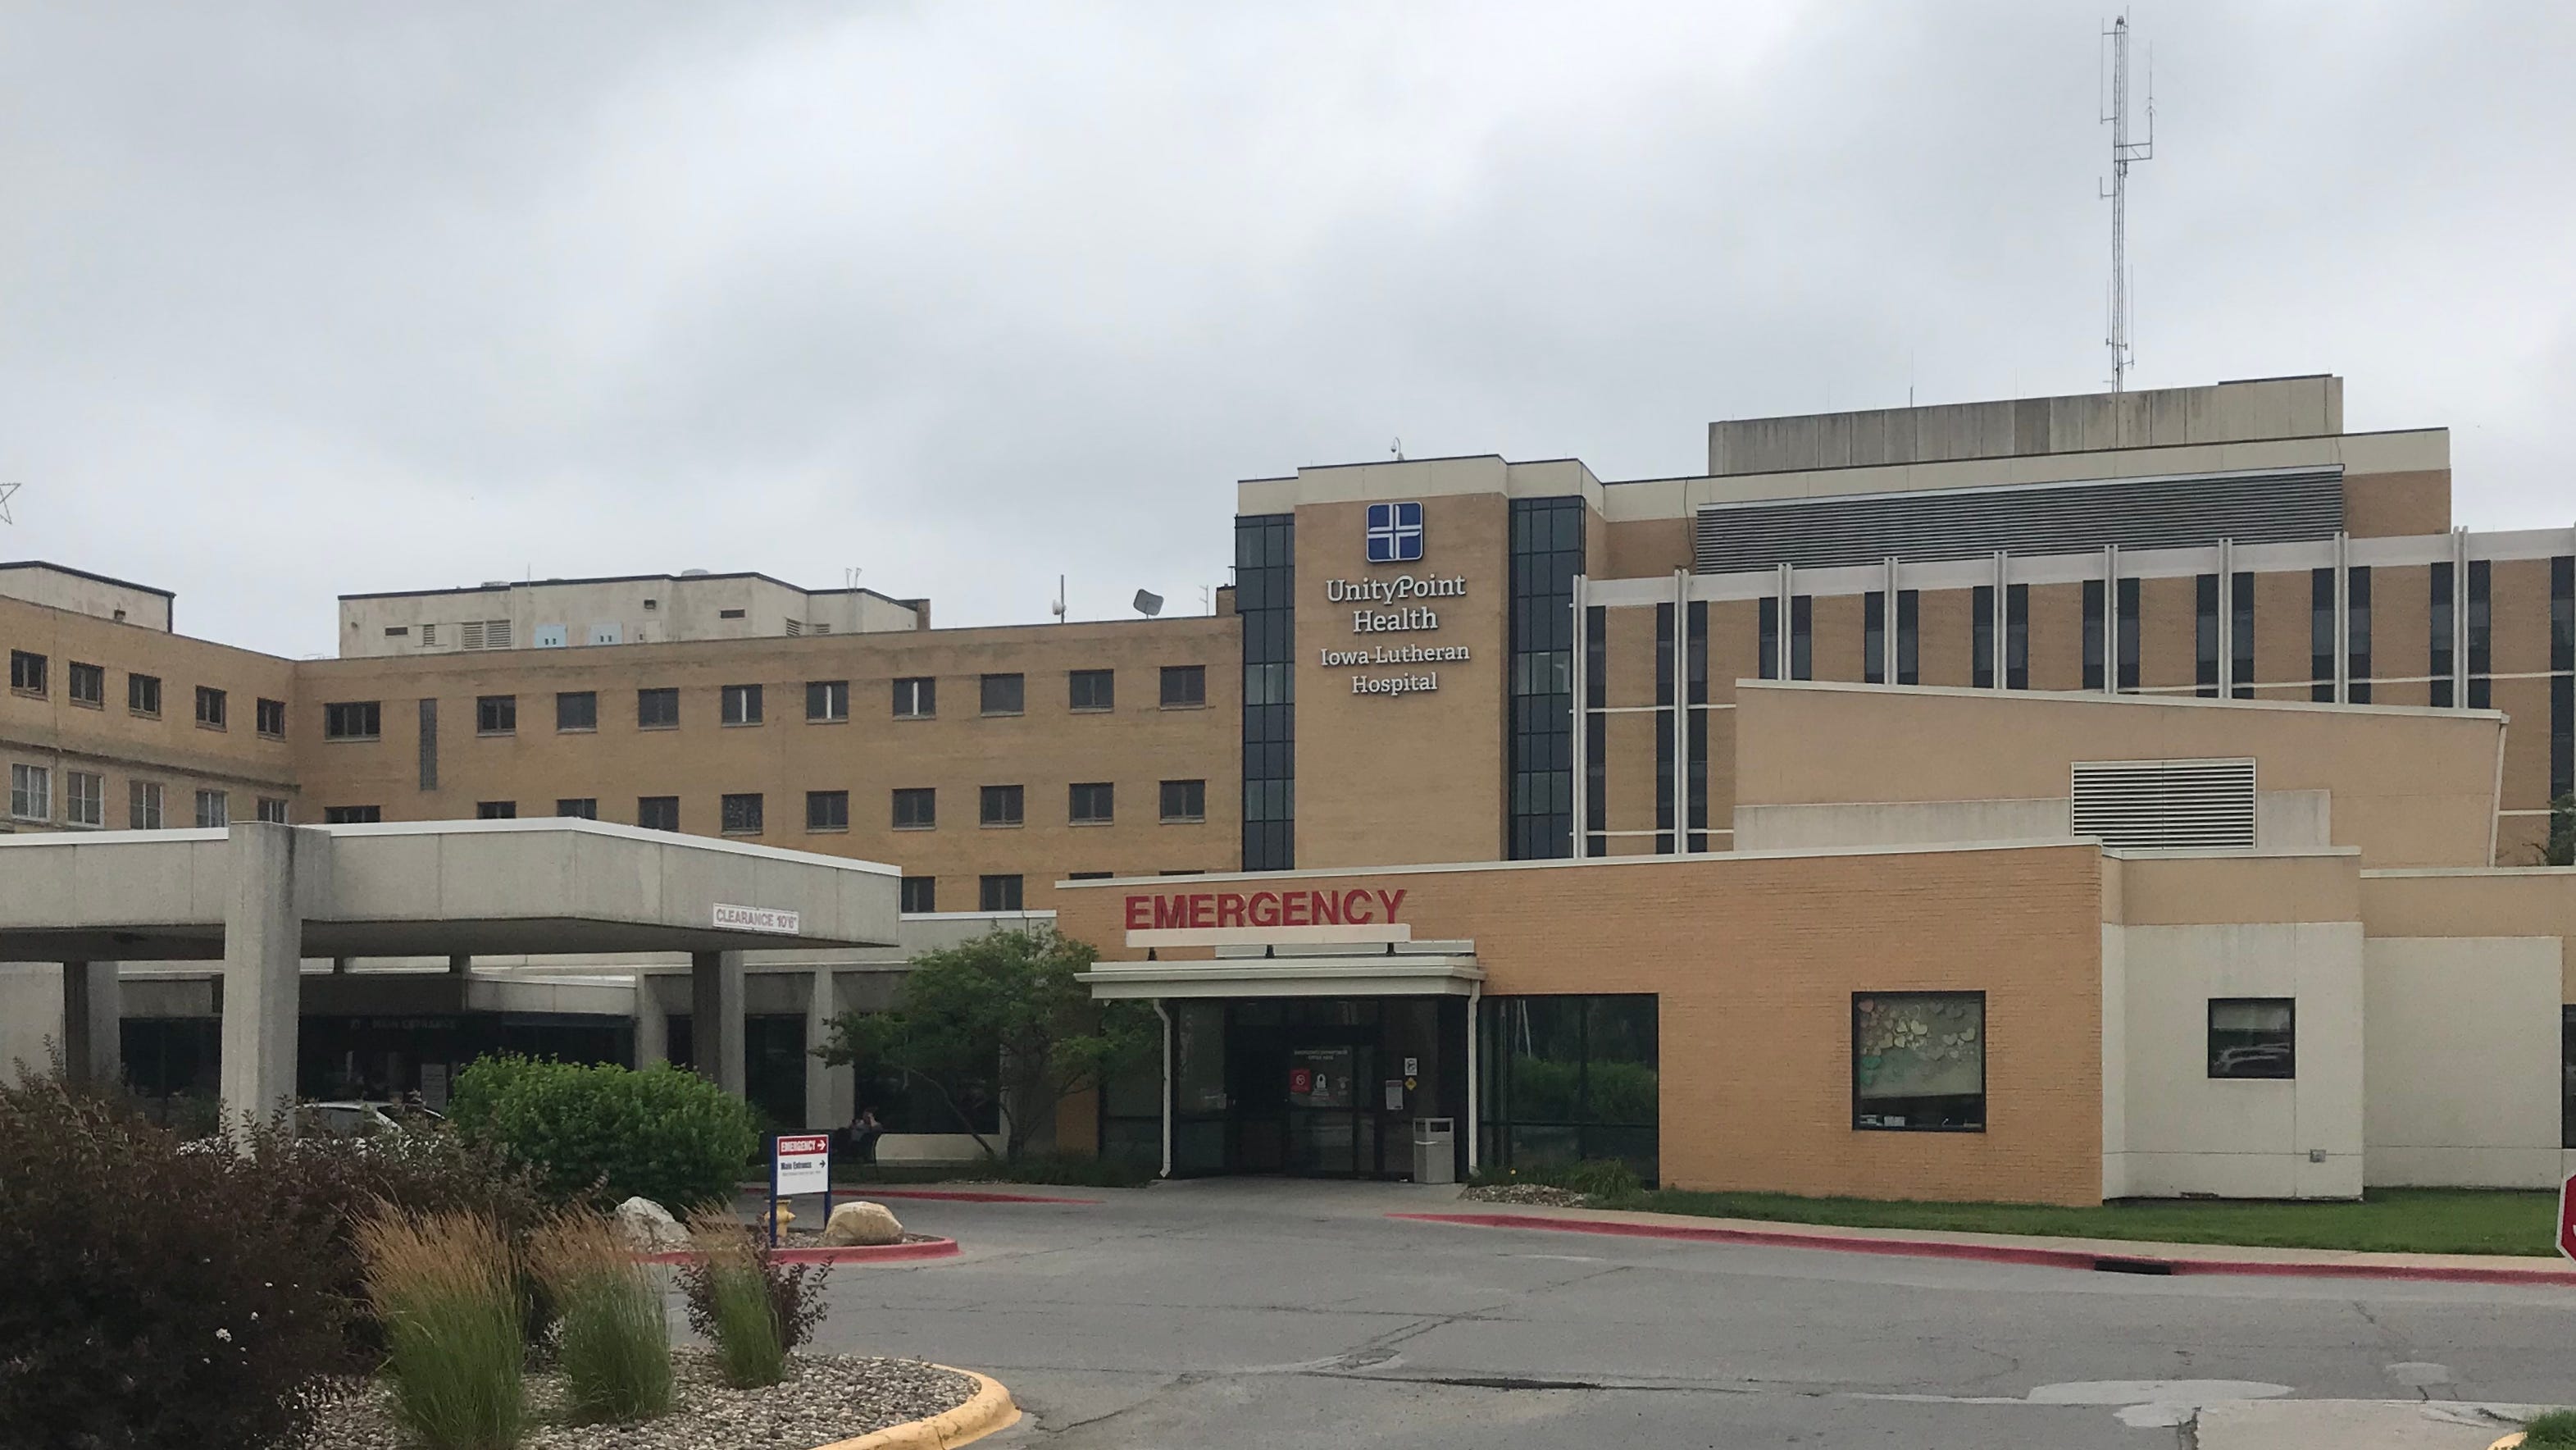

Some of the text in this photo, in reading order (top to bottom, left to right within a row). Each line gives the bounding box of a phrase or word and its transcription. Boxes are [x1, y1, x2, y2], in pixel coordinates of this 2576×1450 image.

[1326, 574, 1466, 605] UnityPoint
[1353, 607, 1438, 633] Health
[1321, 644, 1470, 666] Iowa Lutheran
[1352, 672, 1437, 695] Hospital
[717, 909, 774, 927] CLEARANCE
[1126, 889, 1407, 930] EMERGENCY
[781, 1140, 816, 1153] EMERGENCY
